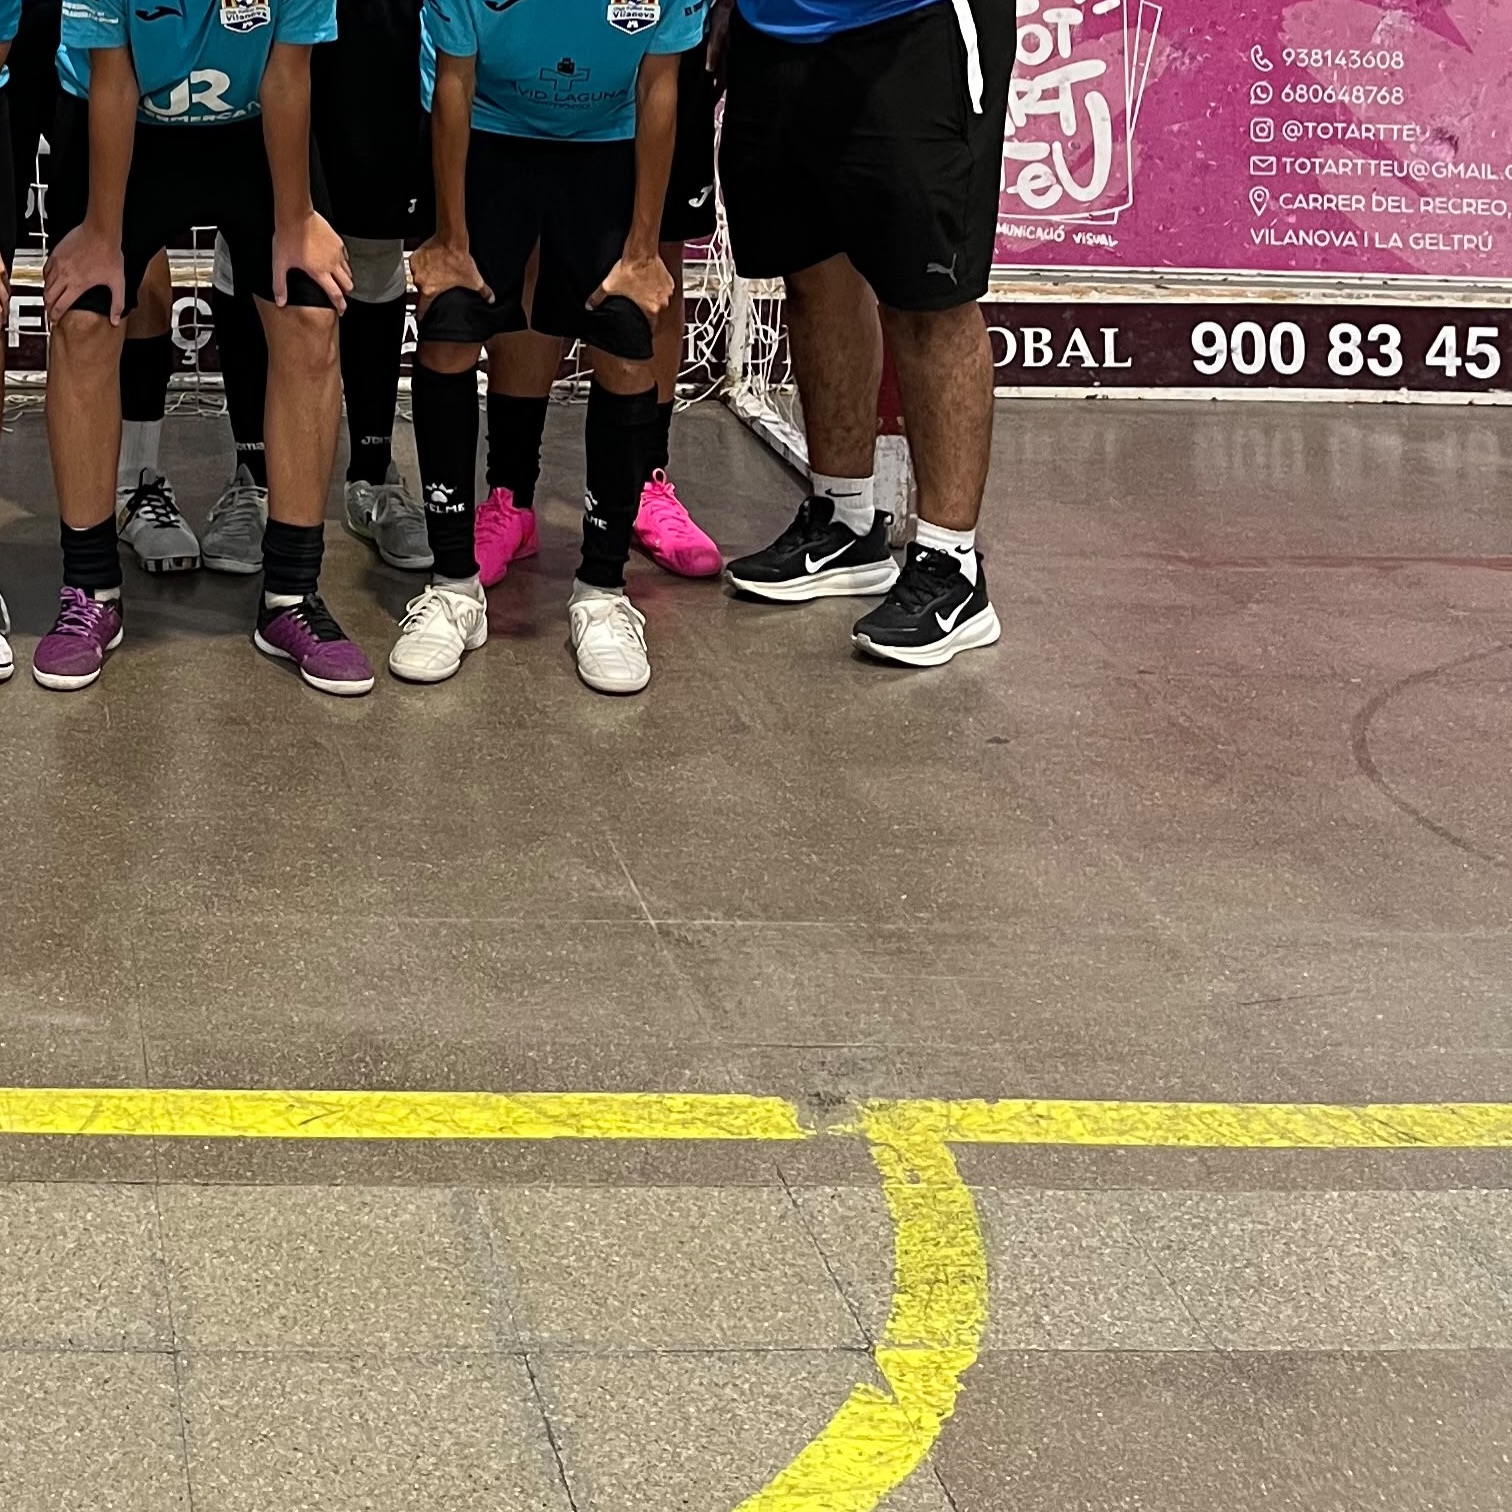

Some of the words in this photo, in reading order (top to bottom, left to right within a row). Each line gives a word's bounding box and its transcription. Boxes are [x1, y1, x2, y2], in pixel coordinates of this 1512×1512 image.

[1282, 48, 1404, 69] 938143608
[1281, 84, 1404, 105] 680648768
[1279, 193, 1365, 211] CARRER
[1372, 192, 1413, 213] DEL
[1420, 197, 1511, 219] RECREO,
[1251, 228, 1358, 248] VILANOVA
[1375, 232, 1403, 248] LA
[1409, 230, 1493, 252] GELTRÚ
[987, 327, 1132, 368] OBAL
[1191, 321, 1306, 376] 900
[1327, 323, 1404, 377] 83
[1425, 325, 1501, 379] 45
